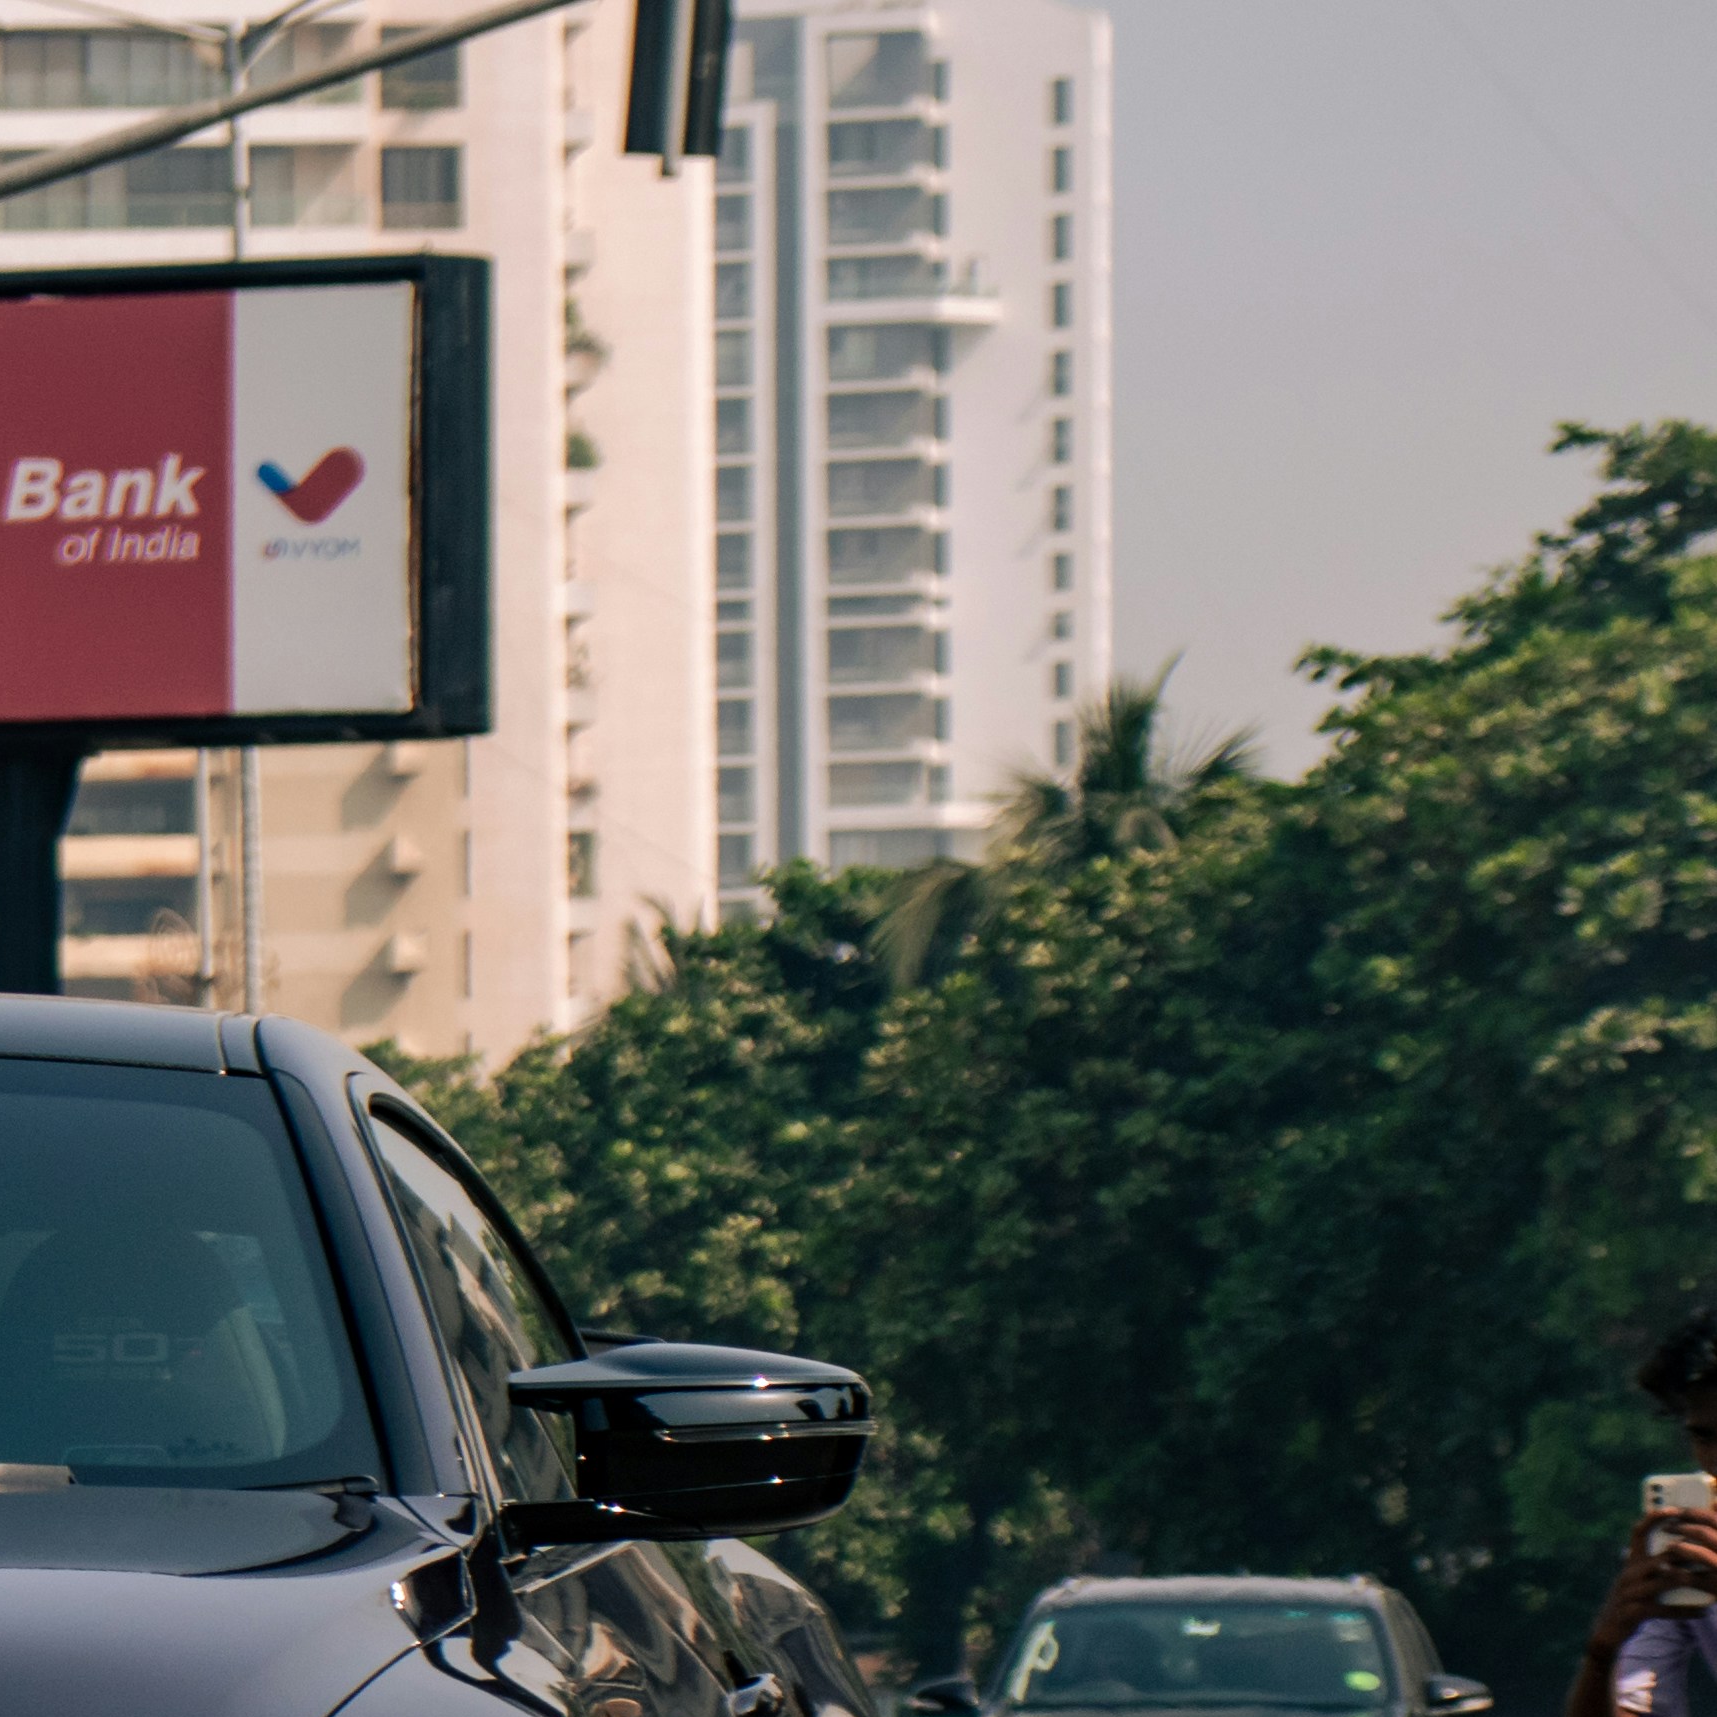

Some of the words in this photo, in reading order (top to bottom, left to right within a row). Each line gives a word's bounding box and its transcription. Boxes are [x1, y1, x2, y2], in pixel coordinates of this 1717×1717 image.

[5, 452, 205, 522] Bank
[58, 529, 102, 566] of
[106, 525, 203, 563] India
